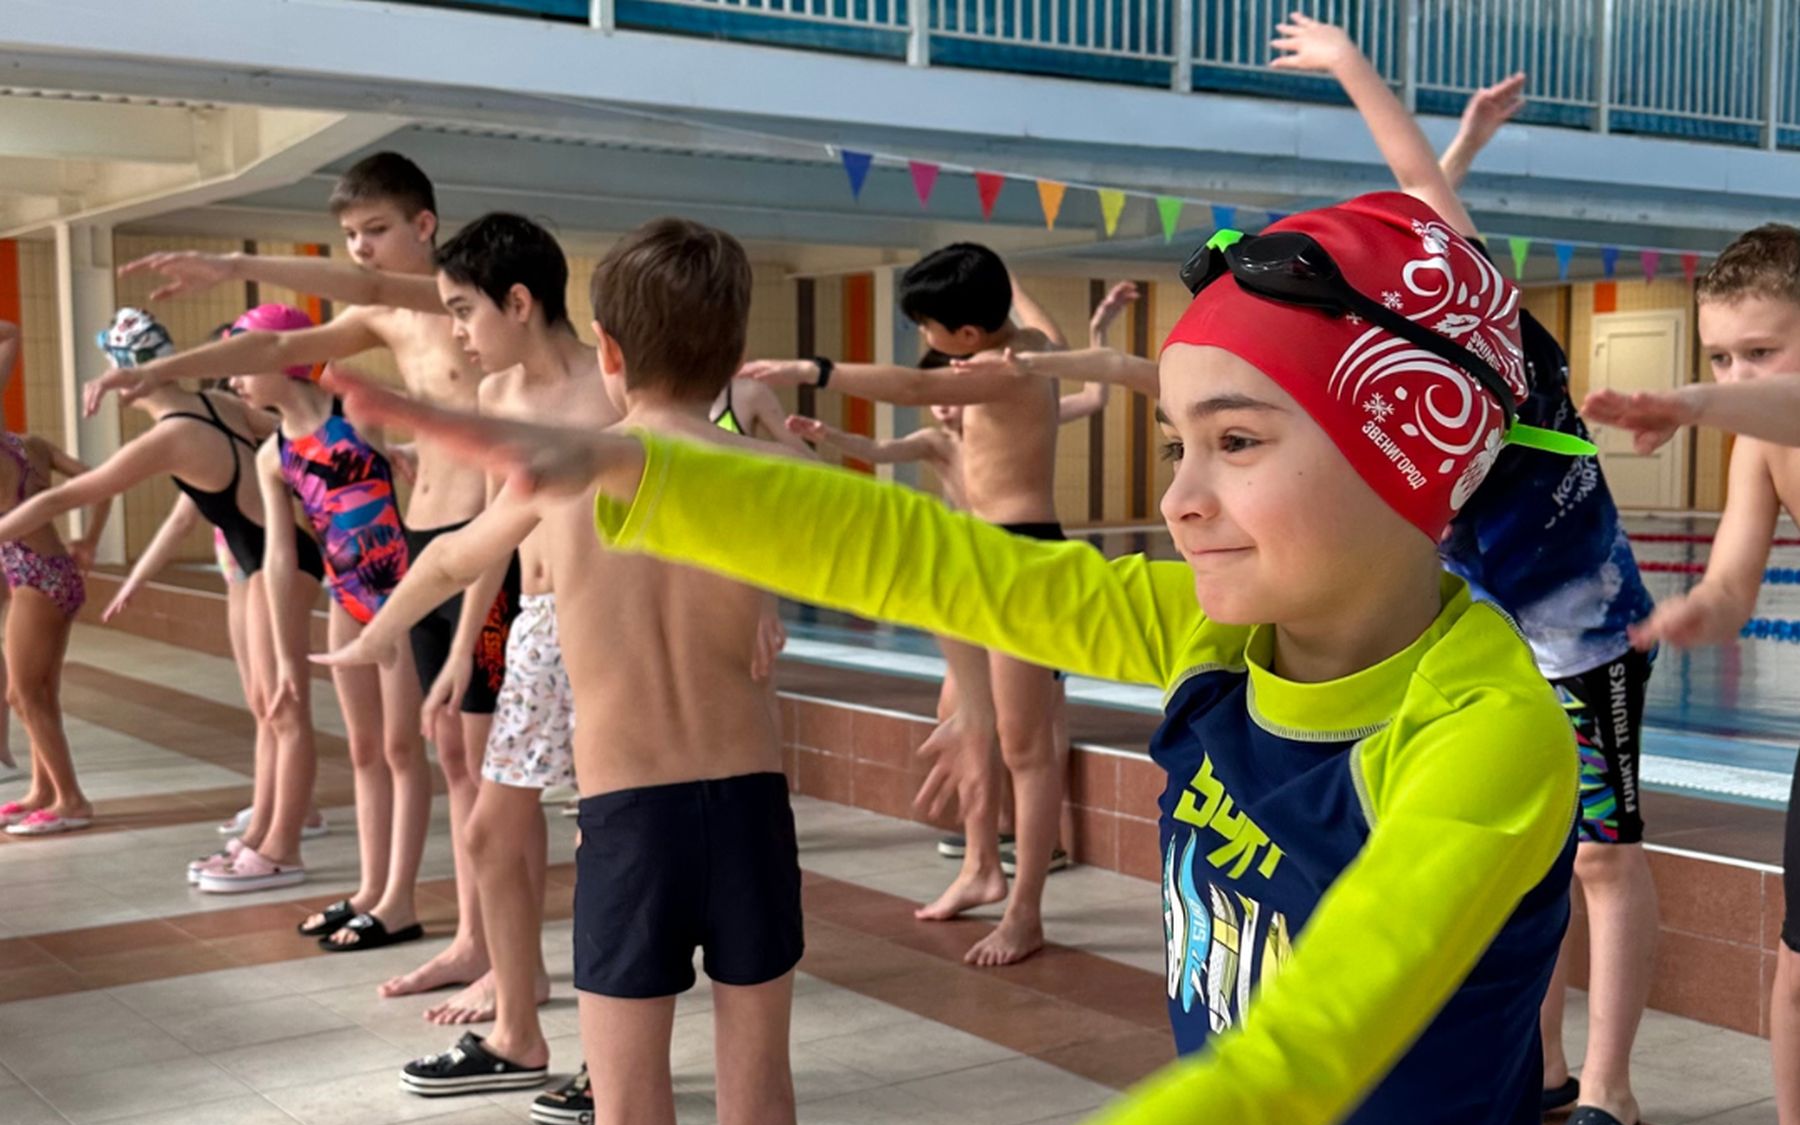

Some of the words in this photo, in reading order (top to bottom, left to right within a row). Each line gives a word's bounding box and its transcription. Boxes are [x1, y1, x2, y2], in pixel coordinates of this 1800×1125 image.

[1361, 420, 1428, 491] ЗВЕНИГОРОД
[1608, 662, 1630, 748] TRUNKS
[1617, 753, 1636, 814] FUNKY
